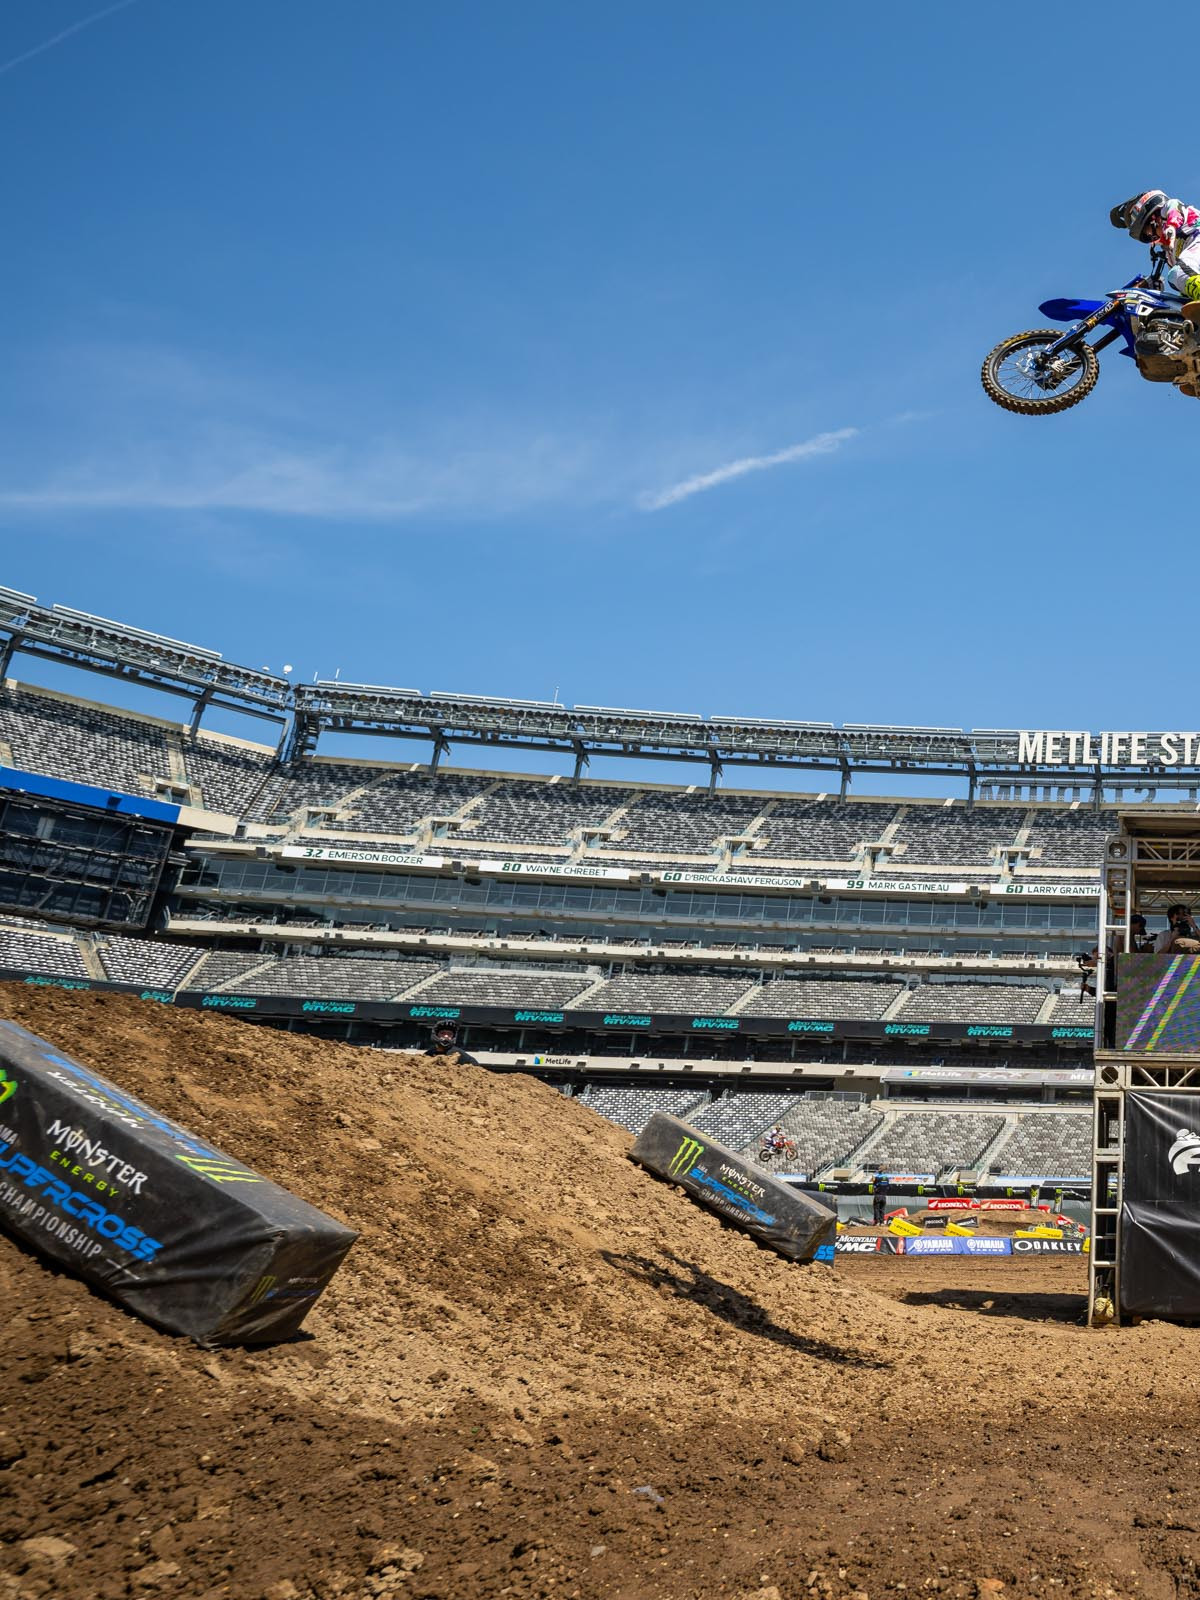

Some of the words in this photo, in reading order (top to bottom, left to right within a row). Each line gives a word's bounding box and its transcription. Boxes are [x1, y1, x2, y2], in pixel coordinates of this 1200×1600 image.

[1017, 731, 1148, 765] METLIFE
[328, 850, 379, 862] EMERSON
[381, 854, 424, 865] BOOZER
[502, 862, 522, 872] 80
[526, 864, 562, 874] WAYNE
[564, 866, 607, 877] CHREBET
[663, 872, 682, 881] 60
[754, 875, 802, 887] FERGUSON
[847, 880, 864, 889] 99
[868, 882, 896, 890] MARK
[898, 883, 949, 892] GASTINEAU
[1027, 886, 1058, 894] LARRY
[46, 1119, 148, 1195] MONSTER
[50, 1150, 120, 1197] ENERGY
[719, 1163, 767, 1198] MONSTER
[689, 1168, 779, 1227] SUPERCROSS
[701, 1188, 752, 1222] CHAMPIONSHIP
[839, 1235, 878, 1243] MOUNTAIN
[923, 1239, 954, 1249] YAMAHA
[975, 1239, 1005, 1249] YAMAHA
[1033, 1240, 1080, 1252] OAKLEY
